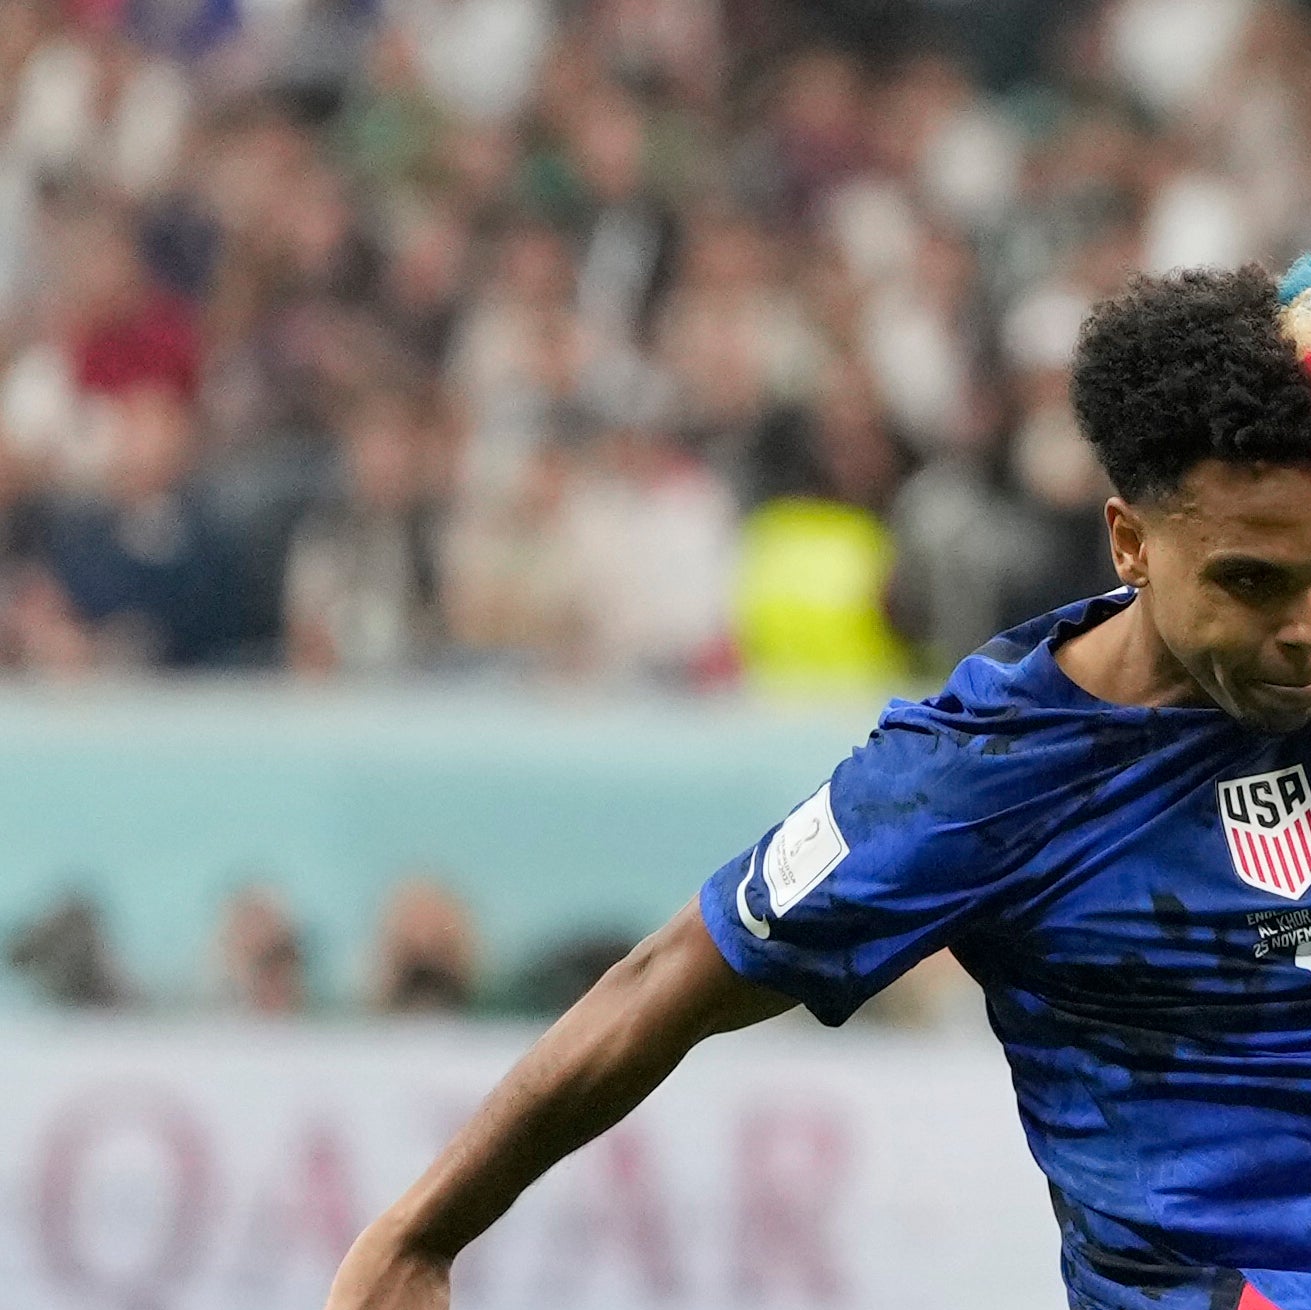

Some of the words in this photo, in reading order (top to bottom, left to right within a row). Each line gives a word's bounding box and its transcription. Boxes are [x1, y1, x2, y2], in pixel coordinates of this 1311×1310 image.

[1222, 771, 1307, 829] USA
[1258, 923, 1278, 939] AL
[1253, 940, 1270, 958] 25
